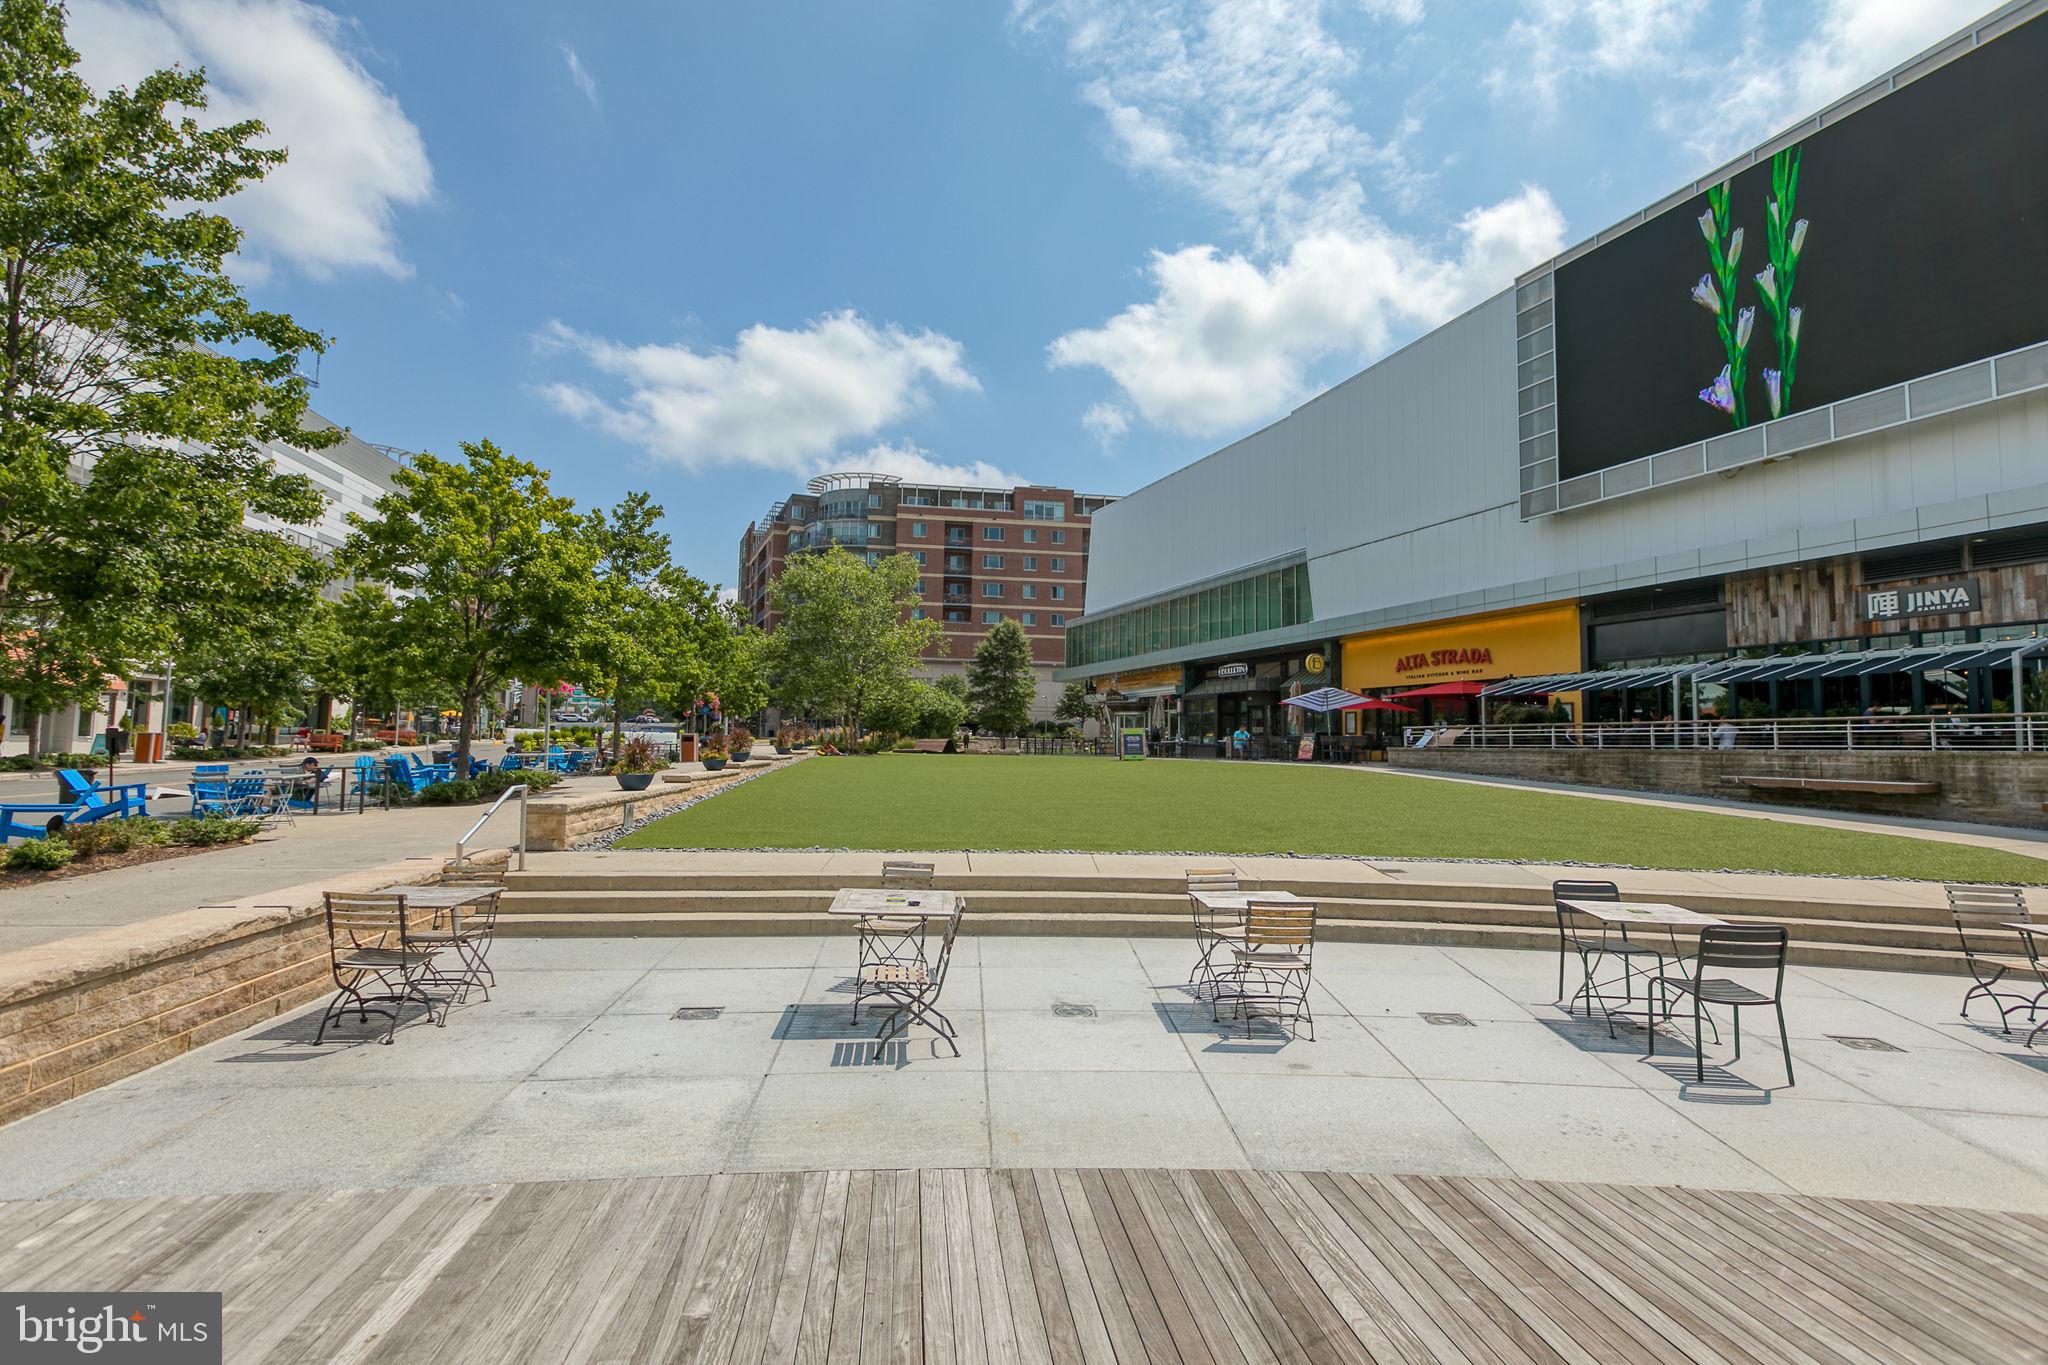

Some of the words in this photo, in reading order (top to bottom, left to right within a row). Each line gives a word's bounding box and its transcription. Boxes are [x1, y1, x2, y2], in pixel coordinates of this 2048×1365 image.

[1907, 587, 1969, 612] JINYA
[1395, 653, 1429, 672] ALTA
[1430, 648, 1492, 666] STRADA
